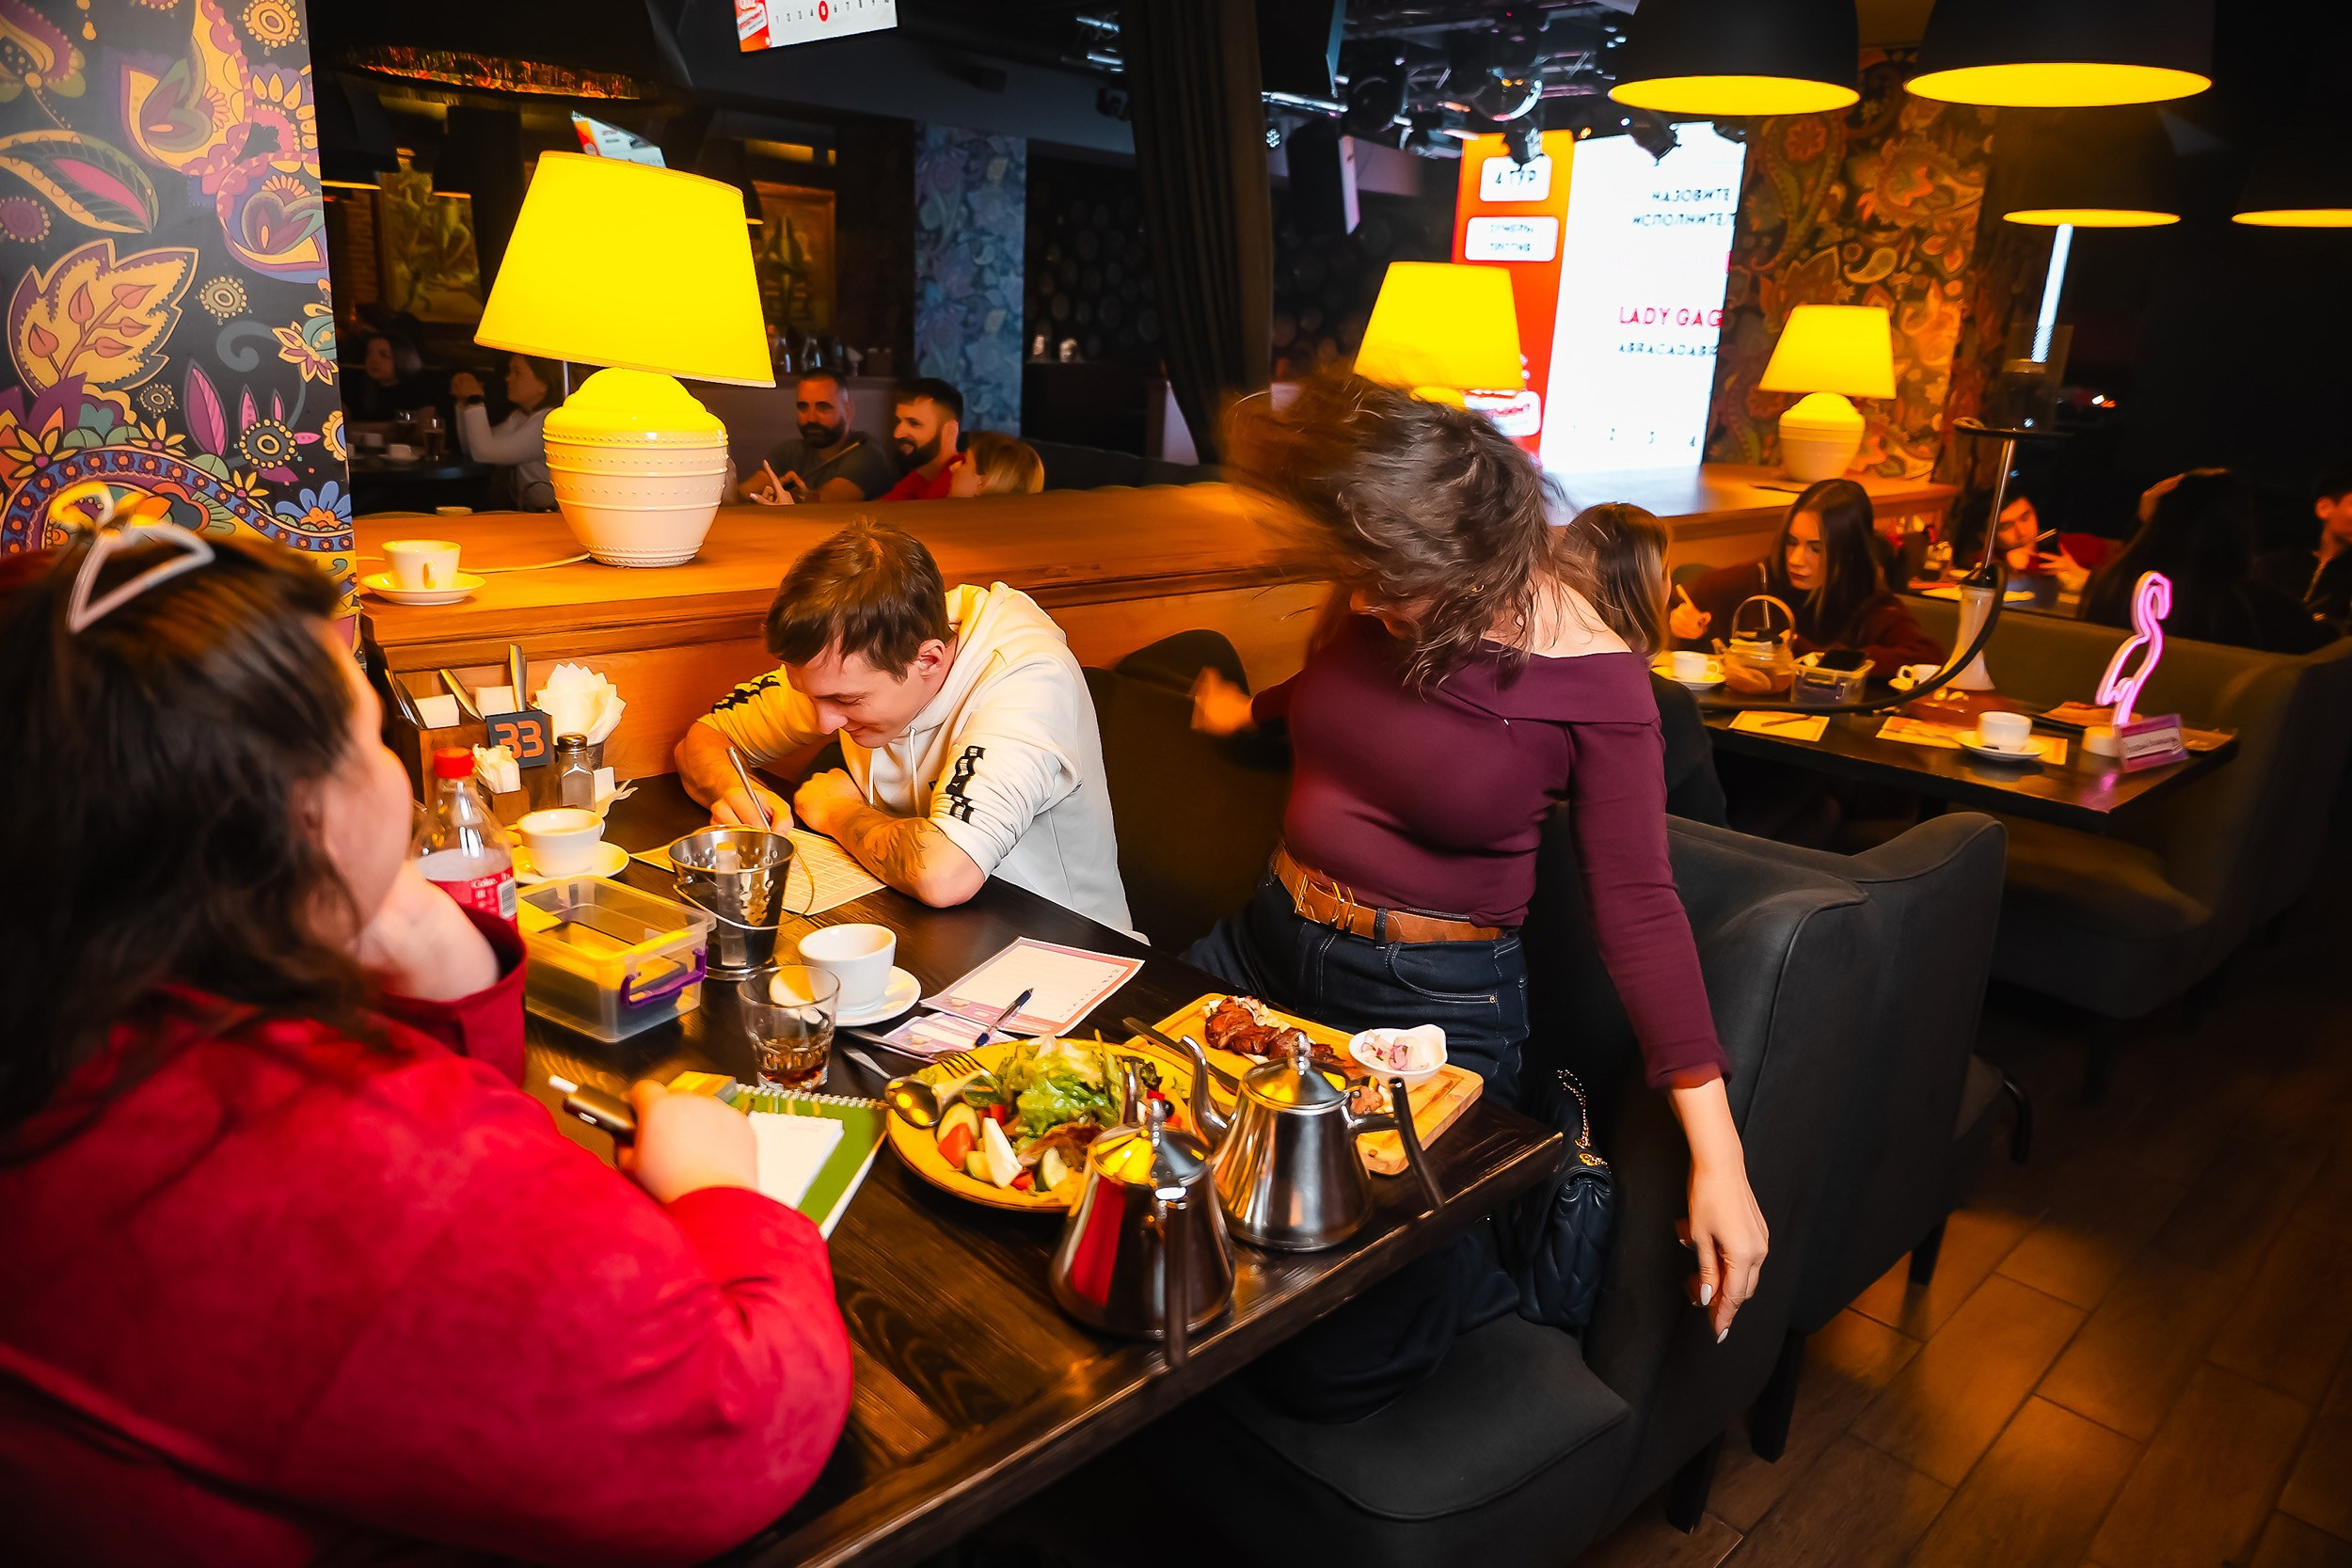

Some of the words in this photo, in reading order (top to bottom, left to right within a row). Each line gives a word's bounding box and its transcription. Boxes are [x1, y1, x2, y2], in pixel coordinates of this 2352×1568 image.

[1619, 307, 1671, 325] LADY
[1677, 308, 1724, 326] GAG
[494, 720, 545, 759] 33
